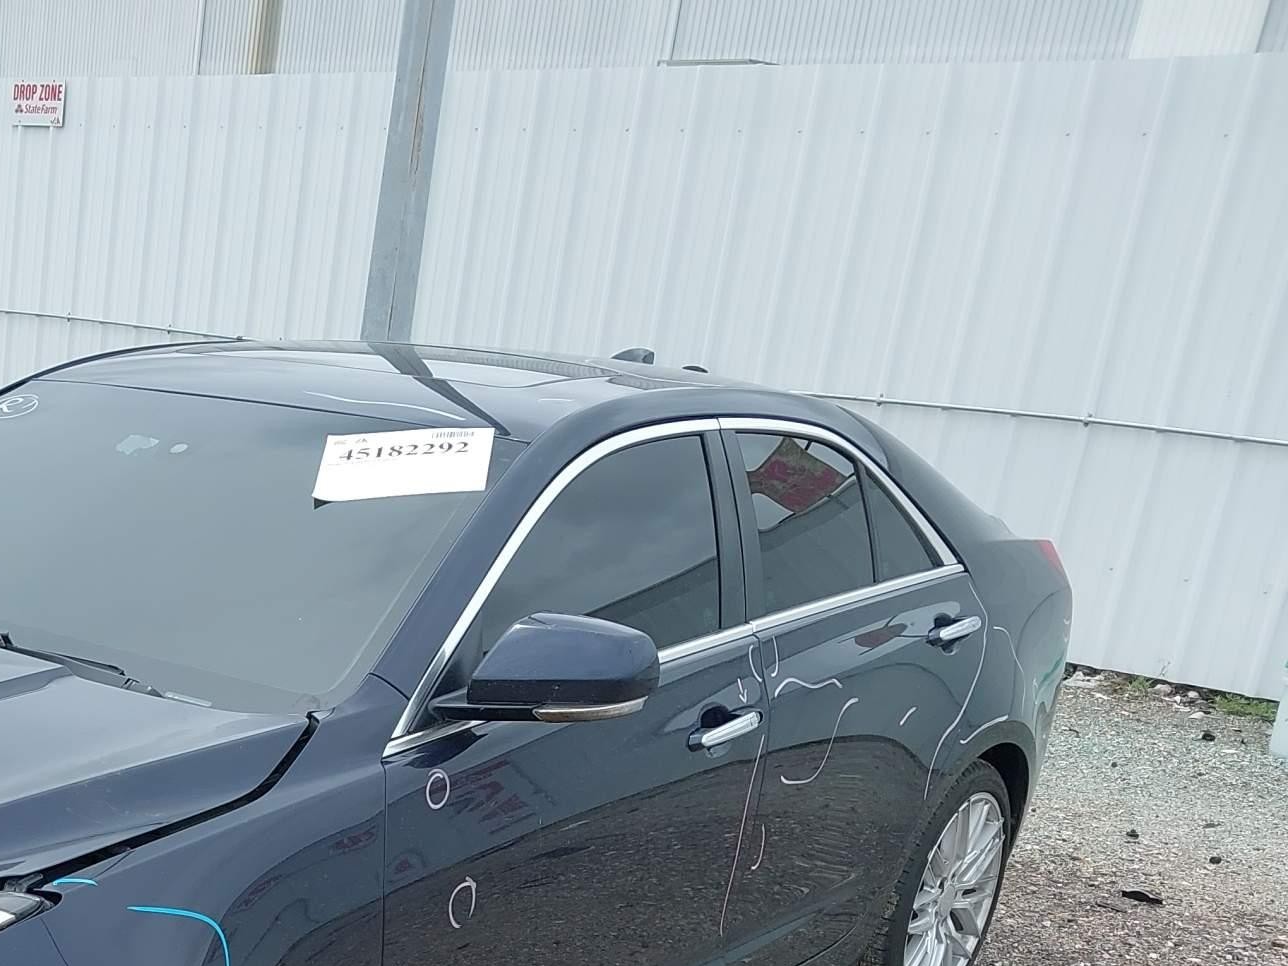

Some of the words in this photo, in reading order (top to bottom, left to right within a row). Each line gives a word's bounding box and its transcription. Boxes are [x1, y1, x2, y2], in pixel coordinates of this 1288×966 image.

[13, 84, 37, 101] DROP
[39, 84, 63, 101] ZONE
[339, 441, 469, 461] 45182292
